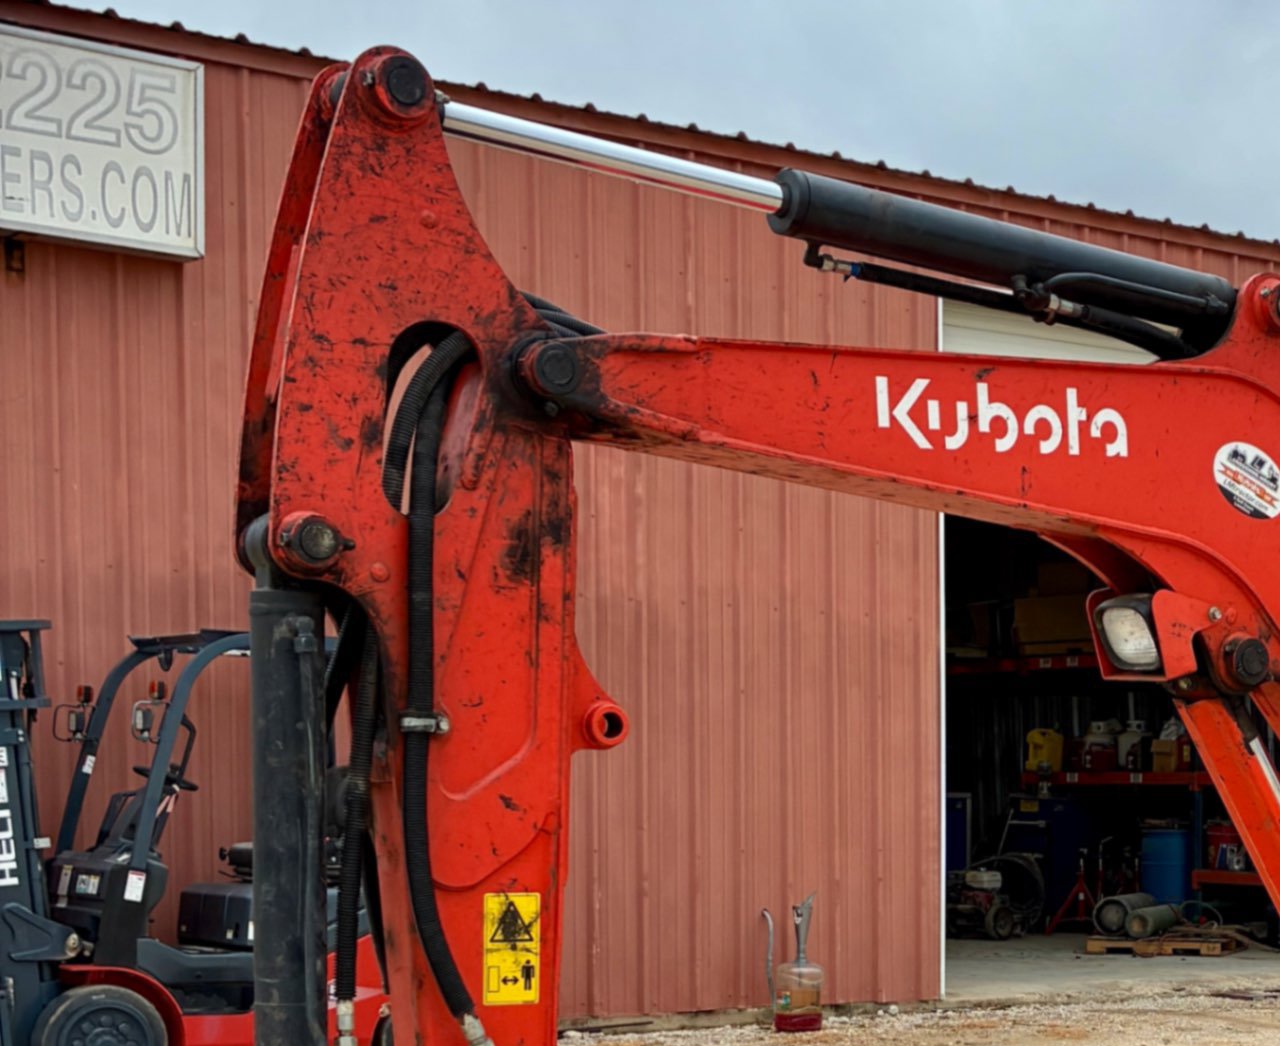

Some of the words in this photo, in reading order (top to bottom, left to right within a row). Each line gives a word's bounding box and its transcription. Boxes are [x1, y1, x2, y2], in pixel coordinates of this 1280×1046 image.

[0, 48, 179, 155] 225
[0, 144, 192, 238] ERS.COM
[875, 375, 1129, 457] Kubota
